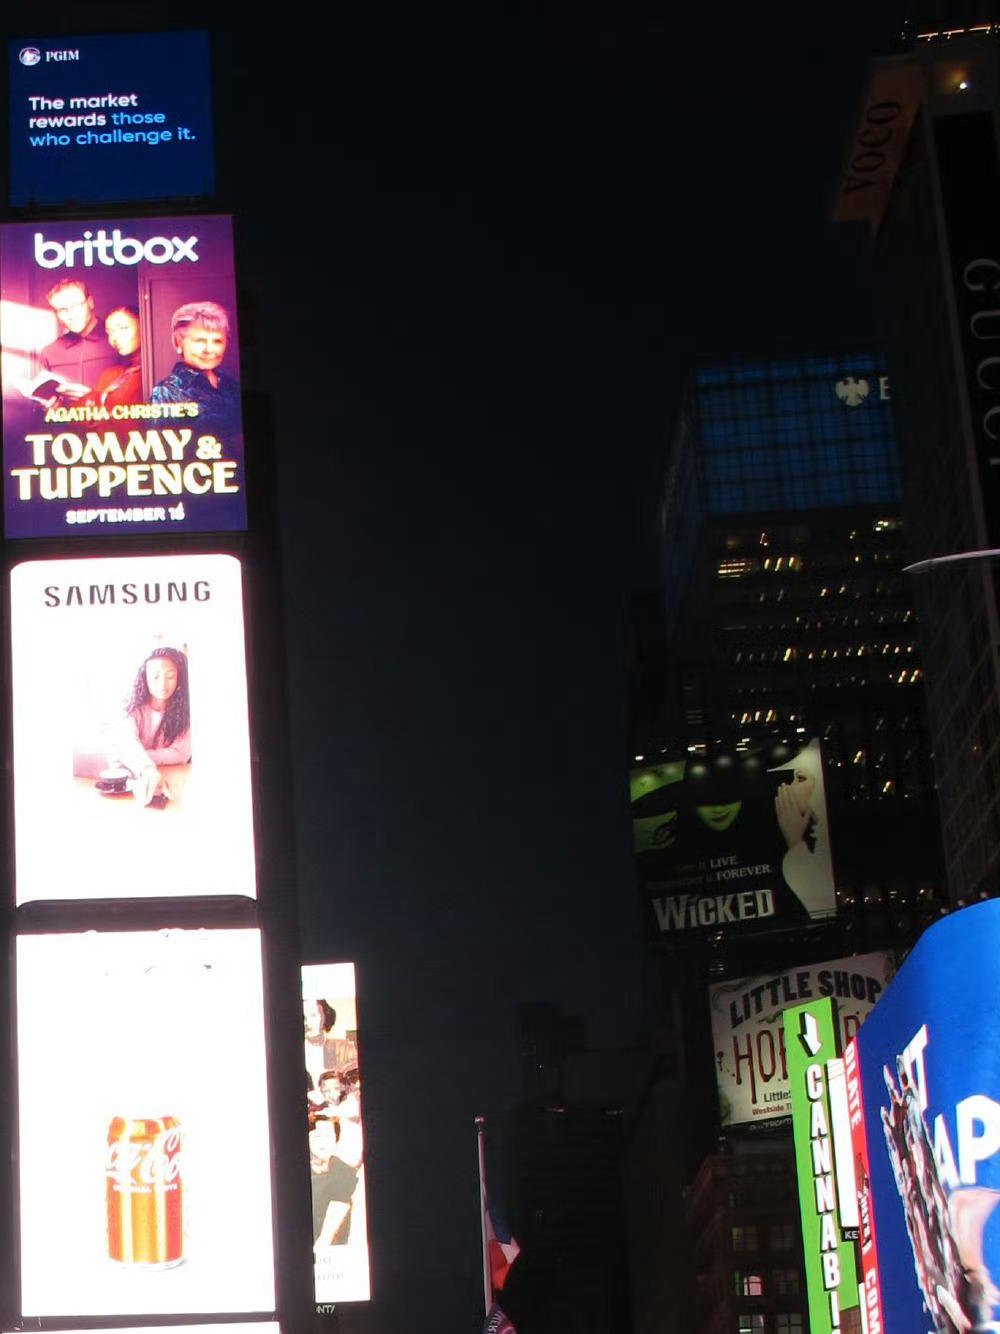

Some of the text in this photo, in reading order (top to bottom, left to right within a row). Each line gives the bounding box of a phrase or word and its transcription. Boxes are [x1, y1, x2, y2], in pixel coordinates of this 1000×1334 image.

[46, 50, 80, 62] PGIM
[29, 94, 138, 110] The market
[29, 113, 165, 128] rewards those
[29, 127, 196, 147] who challenge it.
[34, 230, 199, 269] britbox
[45, 402, 199, 423] AGATHA CHRISTIE'S
[25, 429, 222, 466] TOMMY &
[10, 461, 240, 501] TUPPENCE
[65, 507, 166, 525] SEPTEMBER
[44, 581, 211, 608] SAMSUNG
[730, 972, 812, 1029] LITTLE
[818, 970, 882, 1004] SHOP
